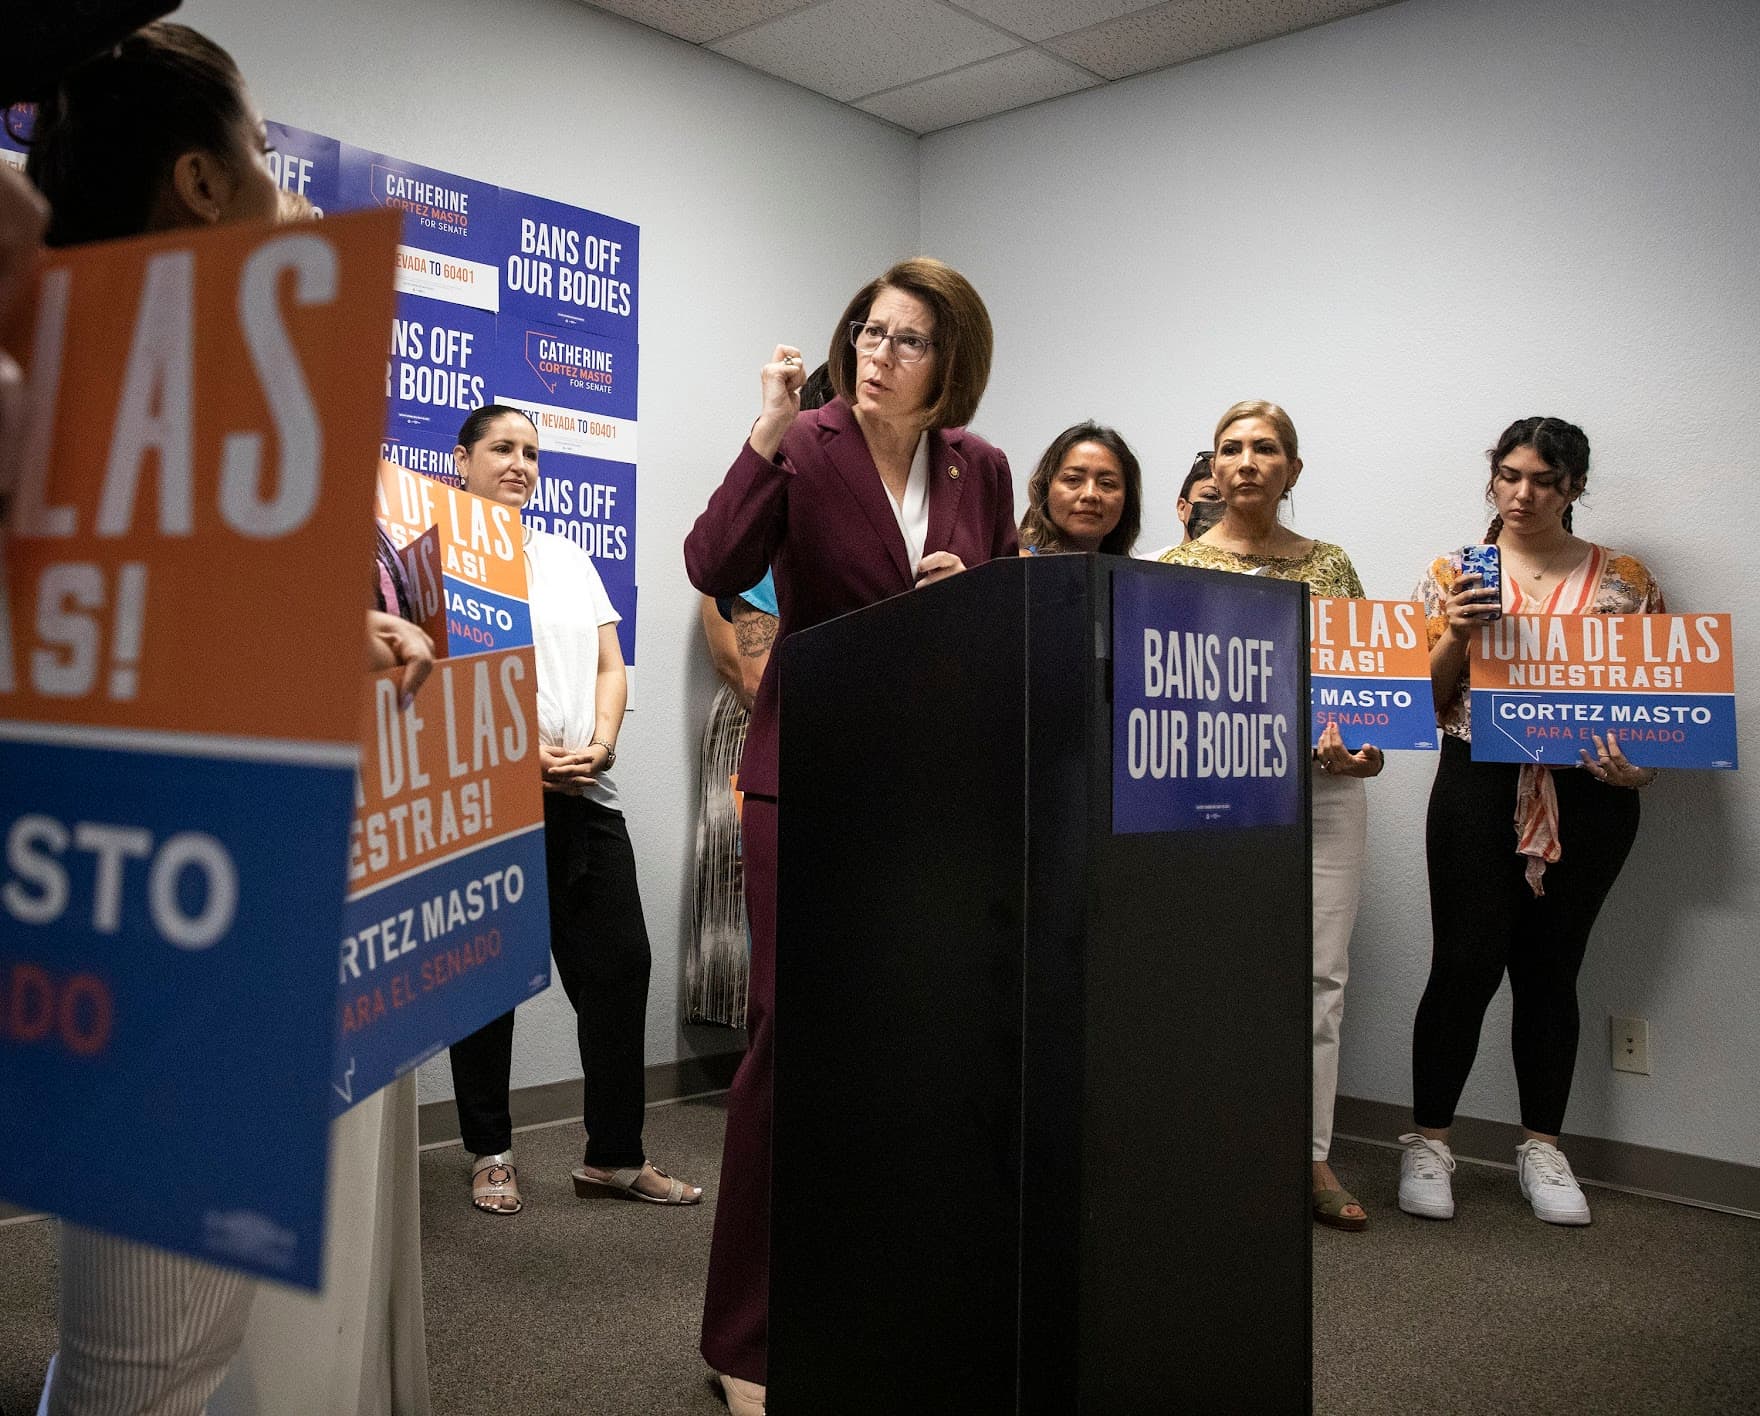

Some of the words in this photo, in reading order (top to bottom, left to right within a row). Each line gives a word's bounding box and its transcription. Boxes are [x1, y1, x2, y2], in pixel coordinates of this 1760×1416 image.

[386, 174, 468, 215] CATHERINE
[386, 196, 428, 217] CORTEZ
[431, 208, 468, 227] MASTO
[420, 217, 436, 228] FOR
[438, 222, 468, 237] SENATE
[521, 218, 579, 265] BANS
[585, 235, 621, 275] OFF
[396, 252, 427, 274] EVADA
[429, 260, 441, 277] TO
[443, 263, 475, 285] 60401
[507, 254, 553, 298] OUR
[559, 266, 631, 317] BODIES
[391, 318, 424, 360] NS
[430, 326, 474, 368] OFF
[539, 339, 613, 373] CATHERINE
[399, 363, 485, 411] BODIES
[539, 361, 578, 378] CORTEZ
[579, 369, 612, 385] MASTO
[569, 378, 584, 389] FOR
[586, 381, 612, 394] SENATE
[541, 412, 576, 432] NEVADA
[578, 418, 588, 434] TO
[589, 421, 617, 439] 60401
[522, 477, 573, 515] ANS
[579, 482, 617, 520] OFF
[447, 489, 515, 561] LAS
[408, 536, 439, 625] AS
[447, 619, 495, 648] NADO
[1347, 602, 1417, 650] LAS
[1582, 617, 1627, 662] DE
[1642, 616, 1720, 664] LAS
[1143, 628, 1221, 701] BANS
[1227, 636, 1274, 703] OFF
[1508, 664, 1683, 689] NUESTRAS!
[1316, 711, 1390, 726] SENADO
[1320, 688, 1412, 708] MASTO
[1500, 702, 1605, 721] CORTEZ
[1611, 705, 1711, 725] MASTO
[376, 678, 430, 799] DE
[442, 656, 528, 778] LAS
[1127, 707, 1188, 779] OUR
[1196, 711, 1287, 779] BODIES
[1525, 726, 1572, 740] PARA
[350, 779, 493, 880] ESTRAS!
[0, 813, 239, 951] STO
[339, 908, 417, 984] RTEZ
[421, 865, 524, 943] MASTO
[342, 989, 385, 1036] ARA
[391, 974, 415, 1010] EL
[421, 927, 502, 993] SENADO
